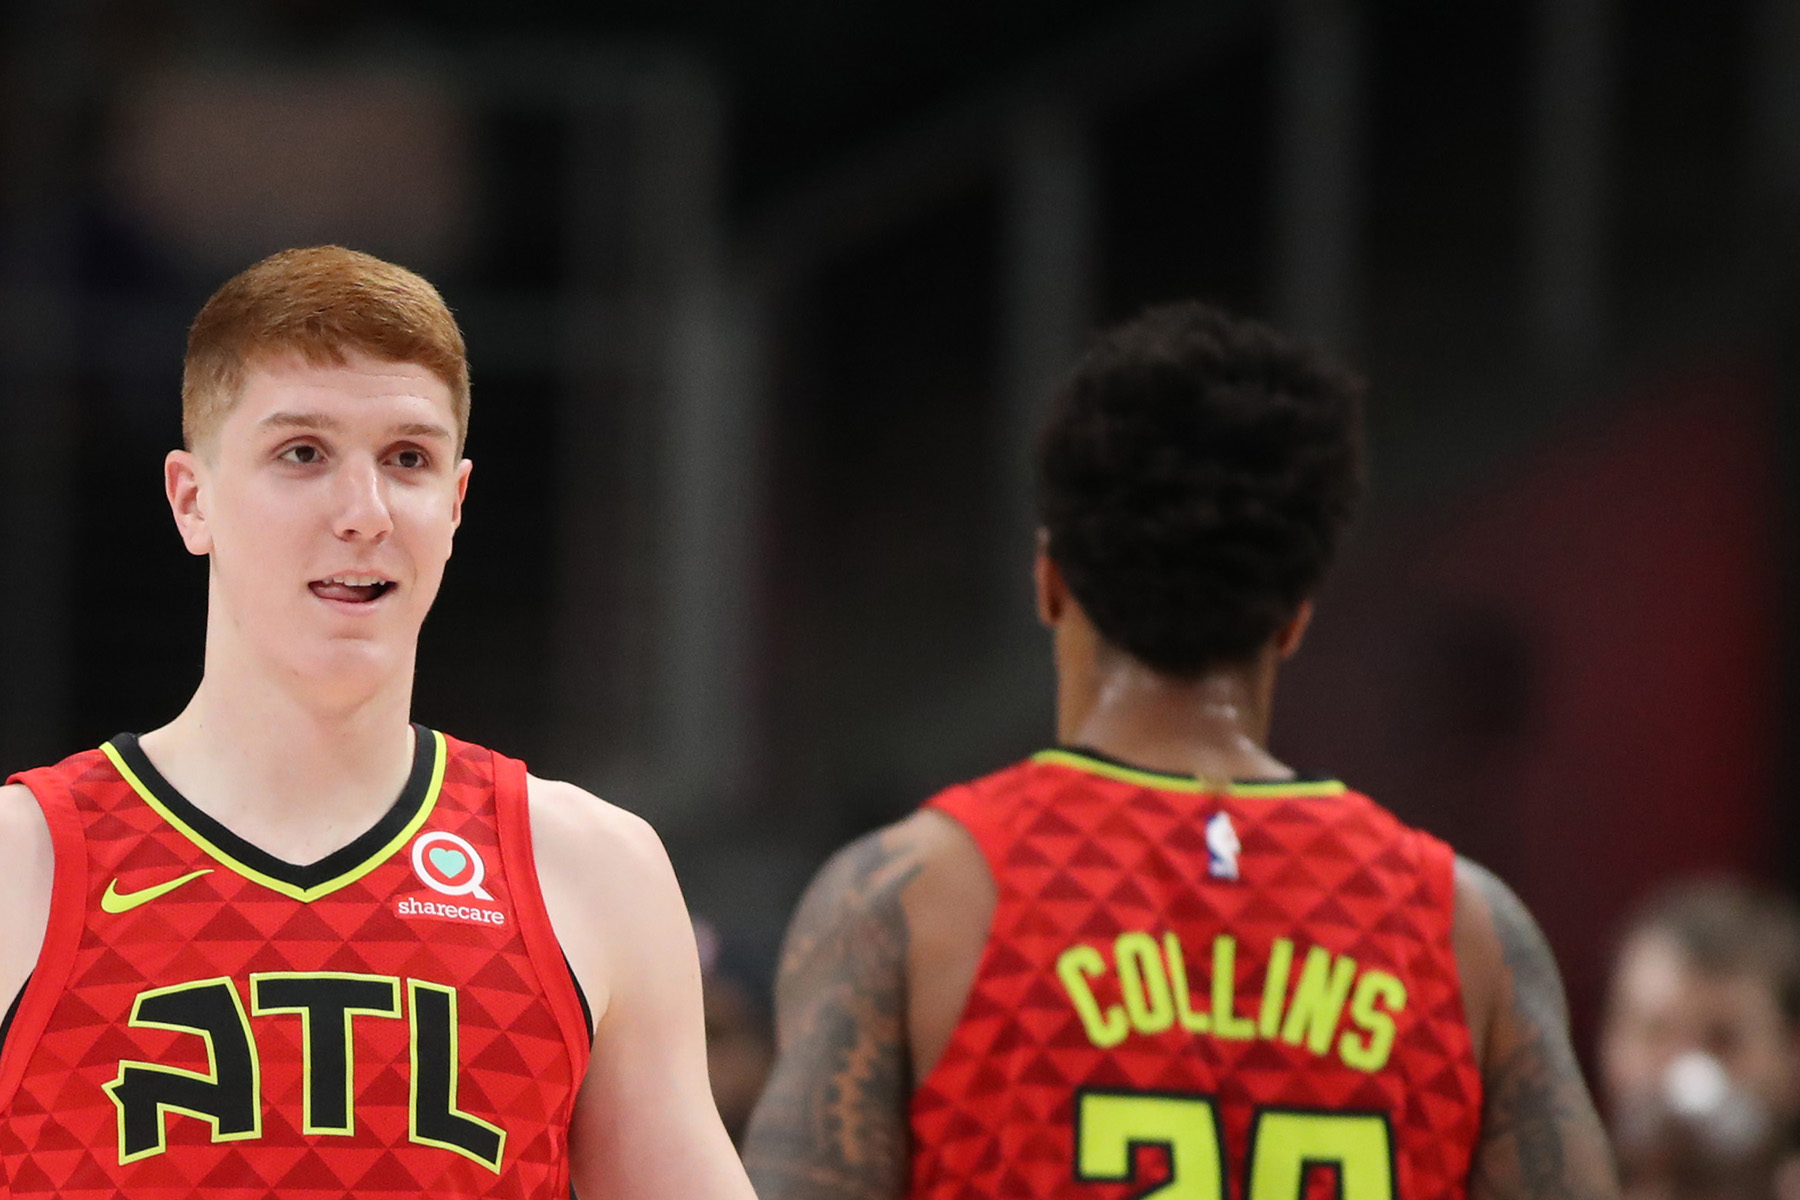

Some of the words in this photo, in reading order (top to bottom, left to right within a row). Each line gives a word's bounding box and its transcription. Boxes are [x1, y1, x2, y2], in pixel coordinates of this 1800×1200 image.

[398, 897, 505, 925] sharecare
[102, 971, 506, 1173] ATL
[1057, 931, 1406, 1073] COLLINS
